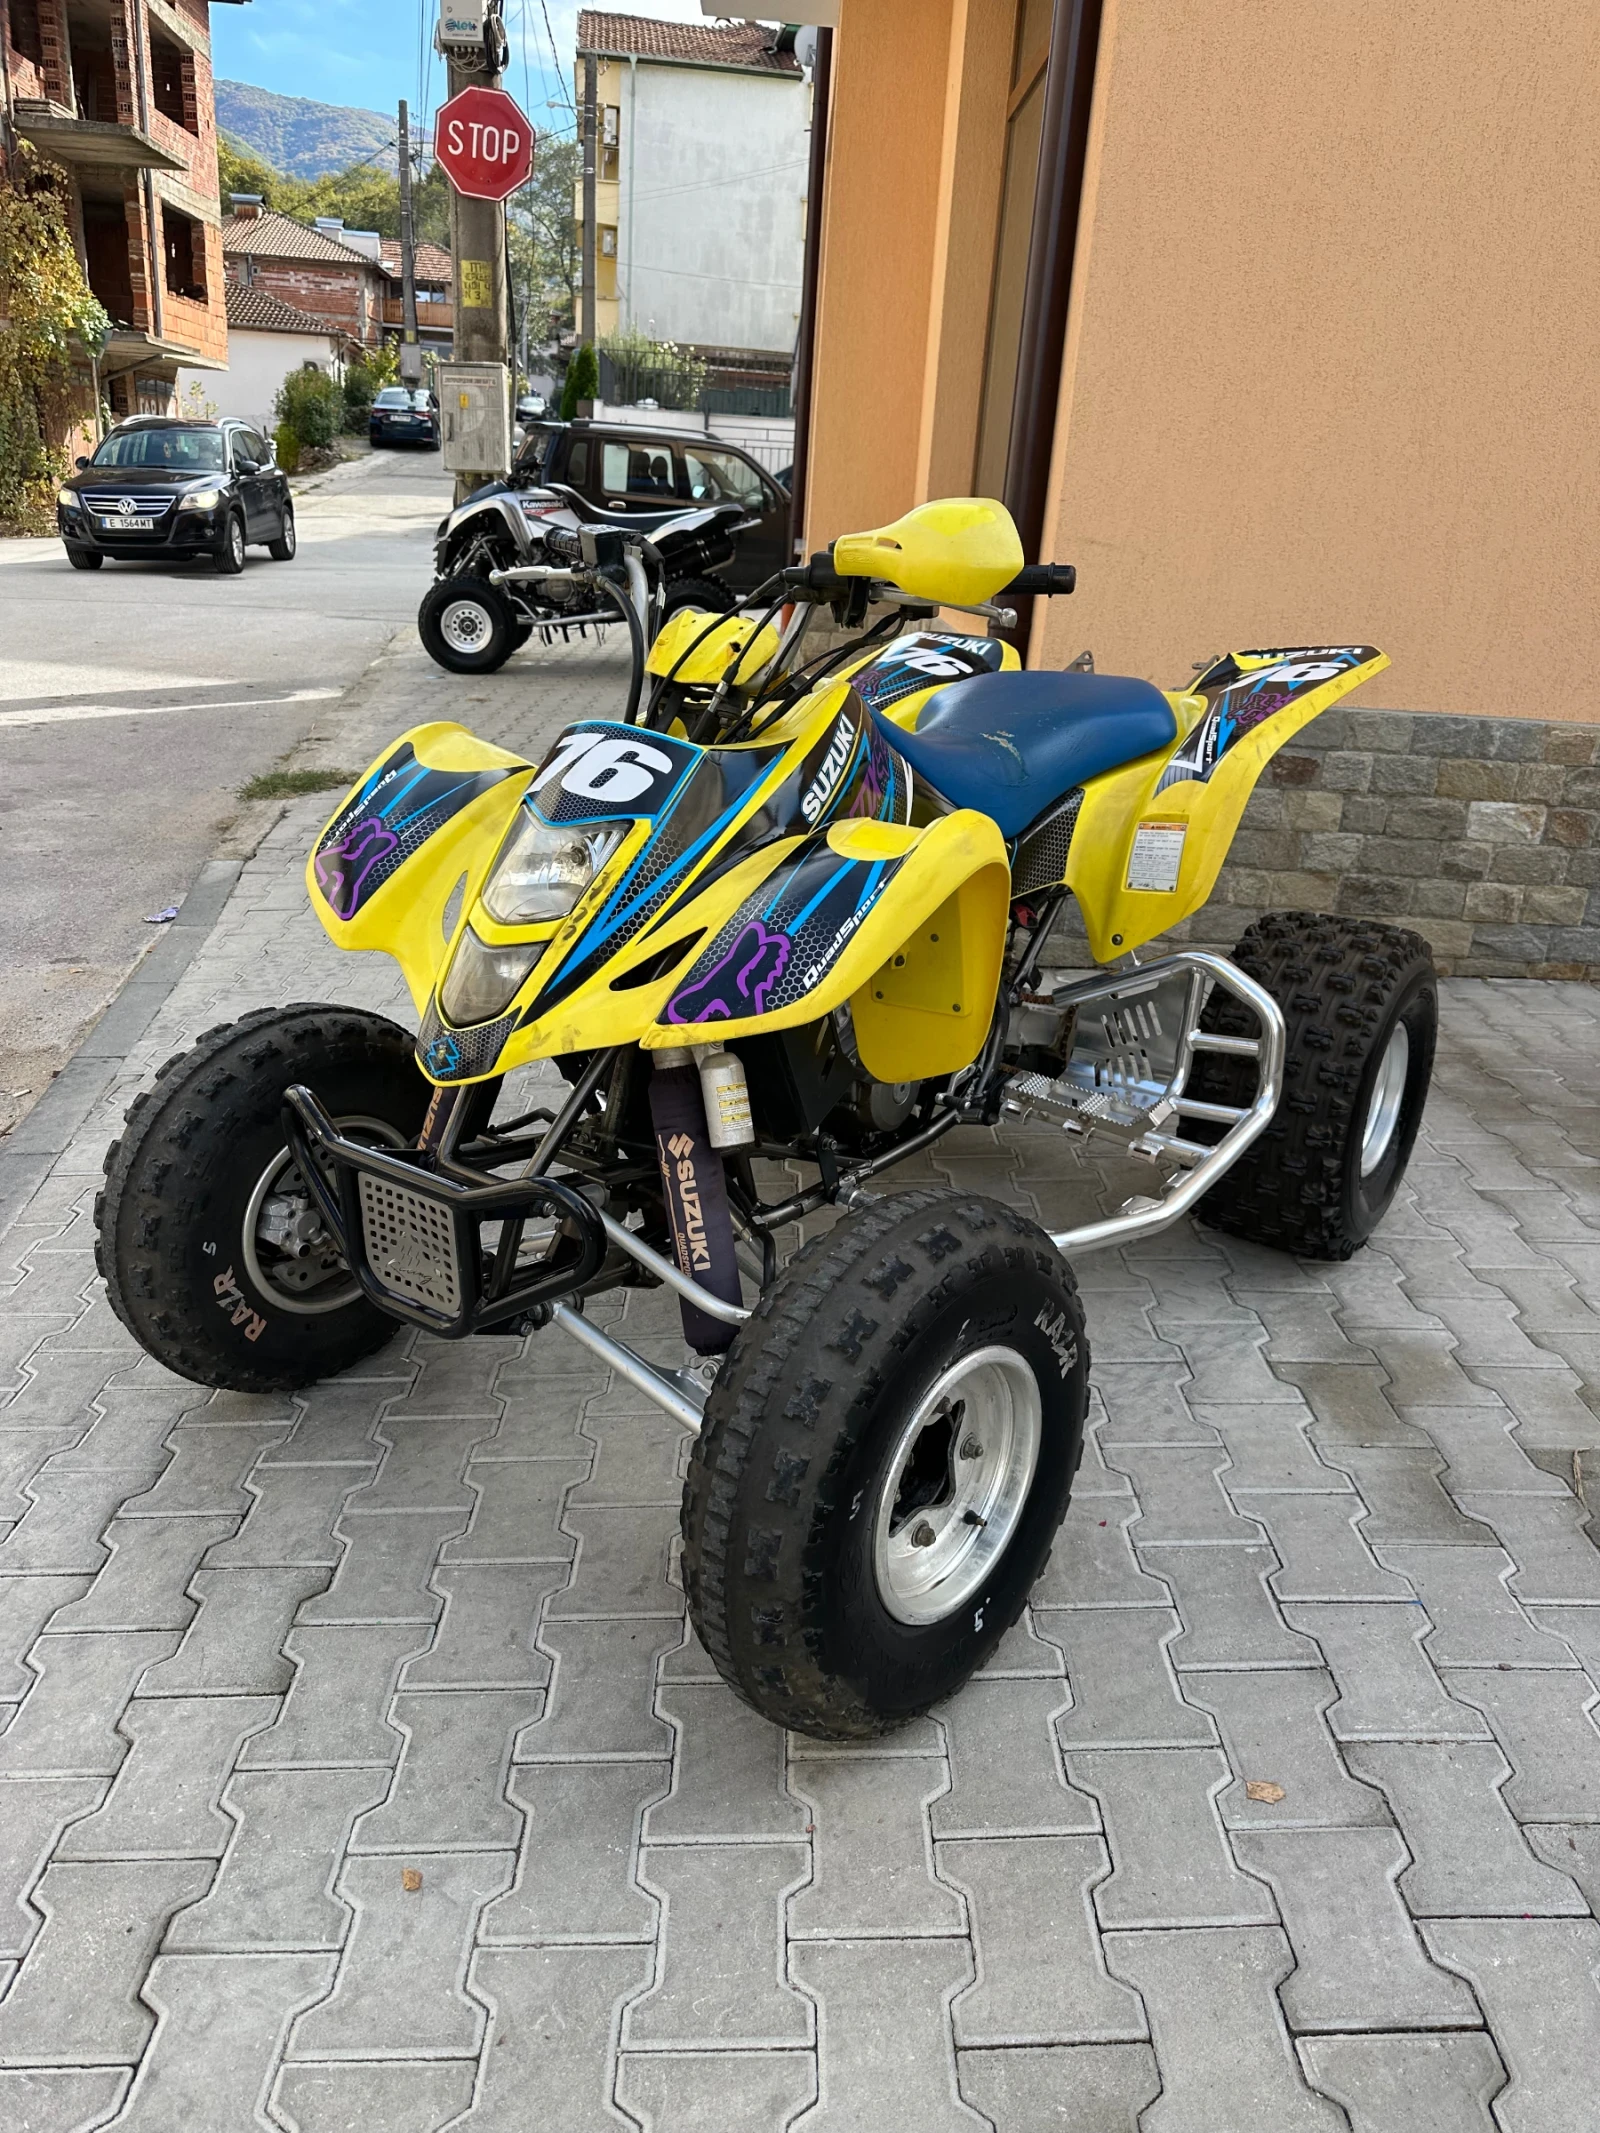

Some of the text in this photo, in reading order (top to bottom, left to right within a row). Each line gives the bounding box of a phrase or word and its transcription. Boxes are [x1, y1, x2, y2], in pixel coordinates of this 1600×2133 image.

[447, 119, 520, 165] STOP
[522, 500, 564, 509] Kawasaki
[874, 646, 974, 677] 76
[916, 632, 993, 656] SUZUKI
[1205, 715, 1221, 765] QuadSport
[802, 711, 856, 823] SUZUKI
[802, 877, 888, 990] QuadSport
[676, 1159, 711, 1271] SUZUKI
[677, 1232, 692, 1278] QUADSPOR
